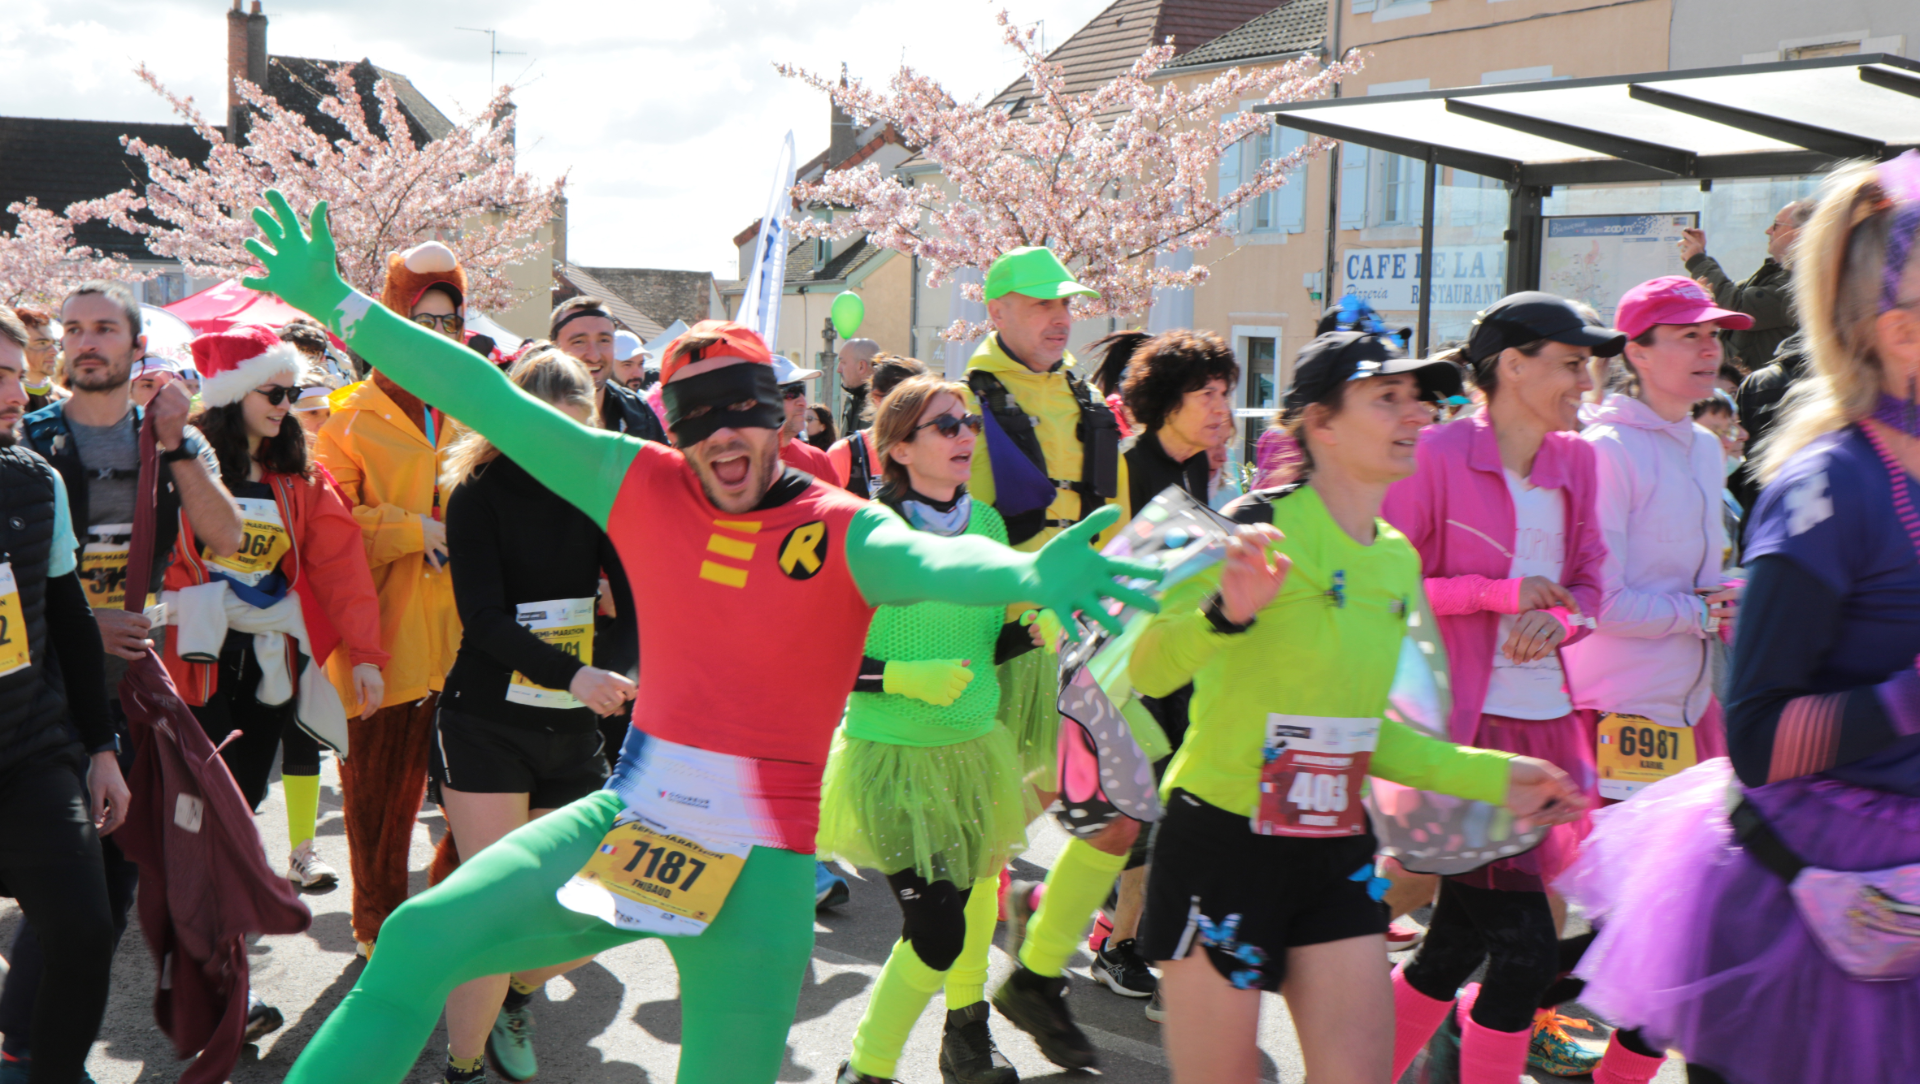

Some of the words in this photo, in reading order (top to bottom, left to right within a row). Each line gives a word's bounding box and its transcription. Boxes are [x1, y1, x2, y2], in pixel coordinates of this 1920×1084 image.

[1604, 224, 1634, 233] zoom
[1346, 253, 1407, 280] CAFE
[1453, 251, 1487, 279] LA
[1346, 284, 1389, 299] Pizzeria
[1411, 284, 1504, 304] RSTAURANT
[779, 520, 825, 576] R
[1620, 726, 1679, 760] 6987
[623, 840, 707, 892] 7187
[631, 878, 672, 899] THIBAUD
